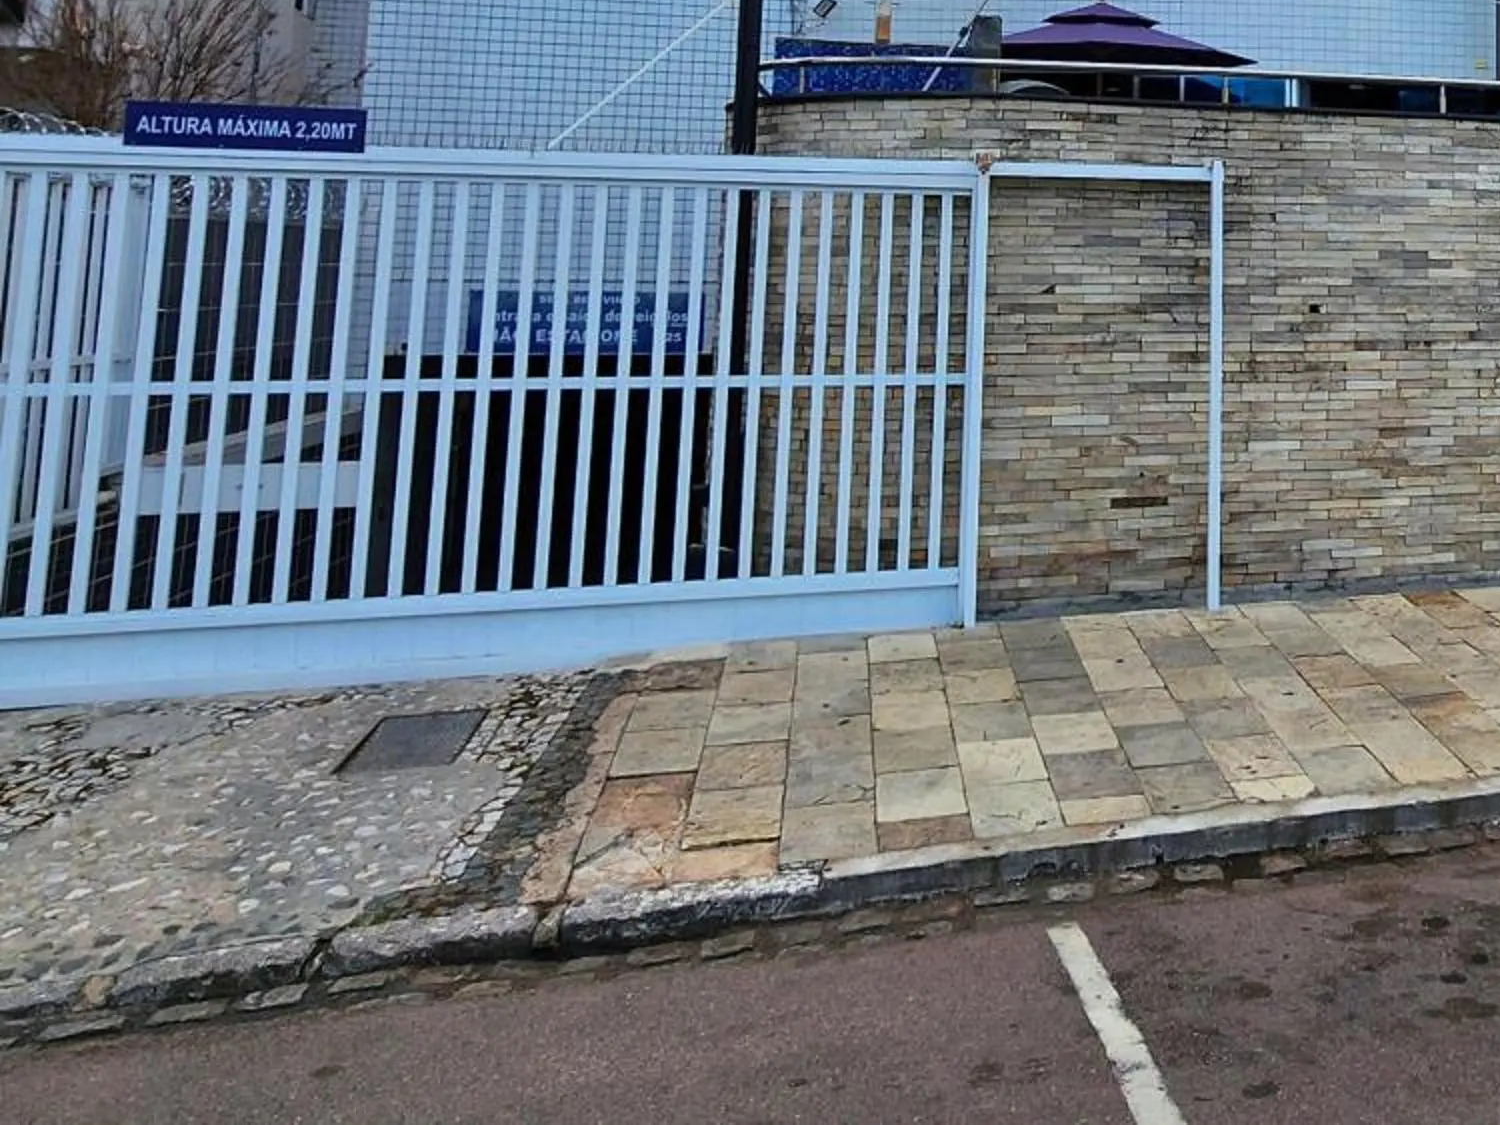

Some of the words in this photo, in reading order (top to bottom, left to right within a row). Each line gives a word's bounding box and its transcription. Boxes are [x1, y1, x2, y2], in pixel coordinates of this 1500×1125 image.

[135, 115, 213, 136] ALTURA
[217, 114, 292, 138] MÁXIMA
[295, 121, 358, 142] 2,20MT
